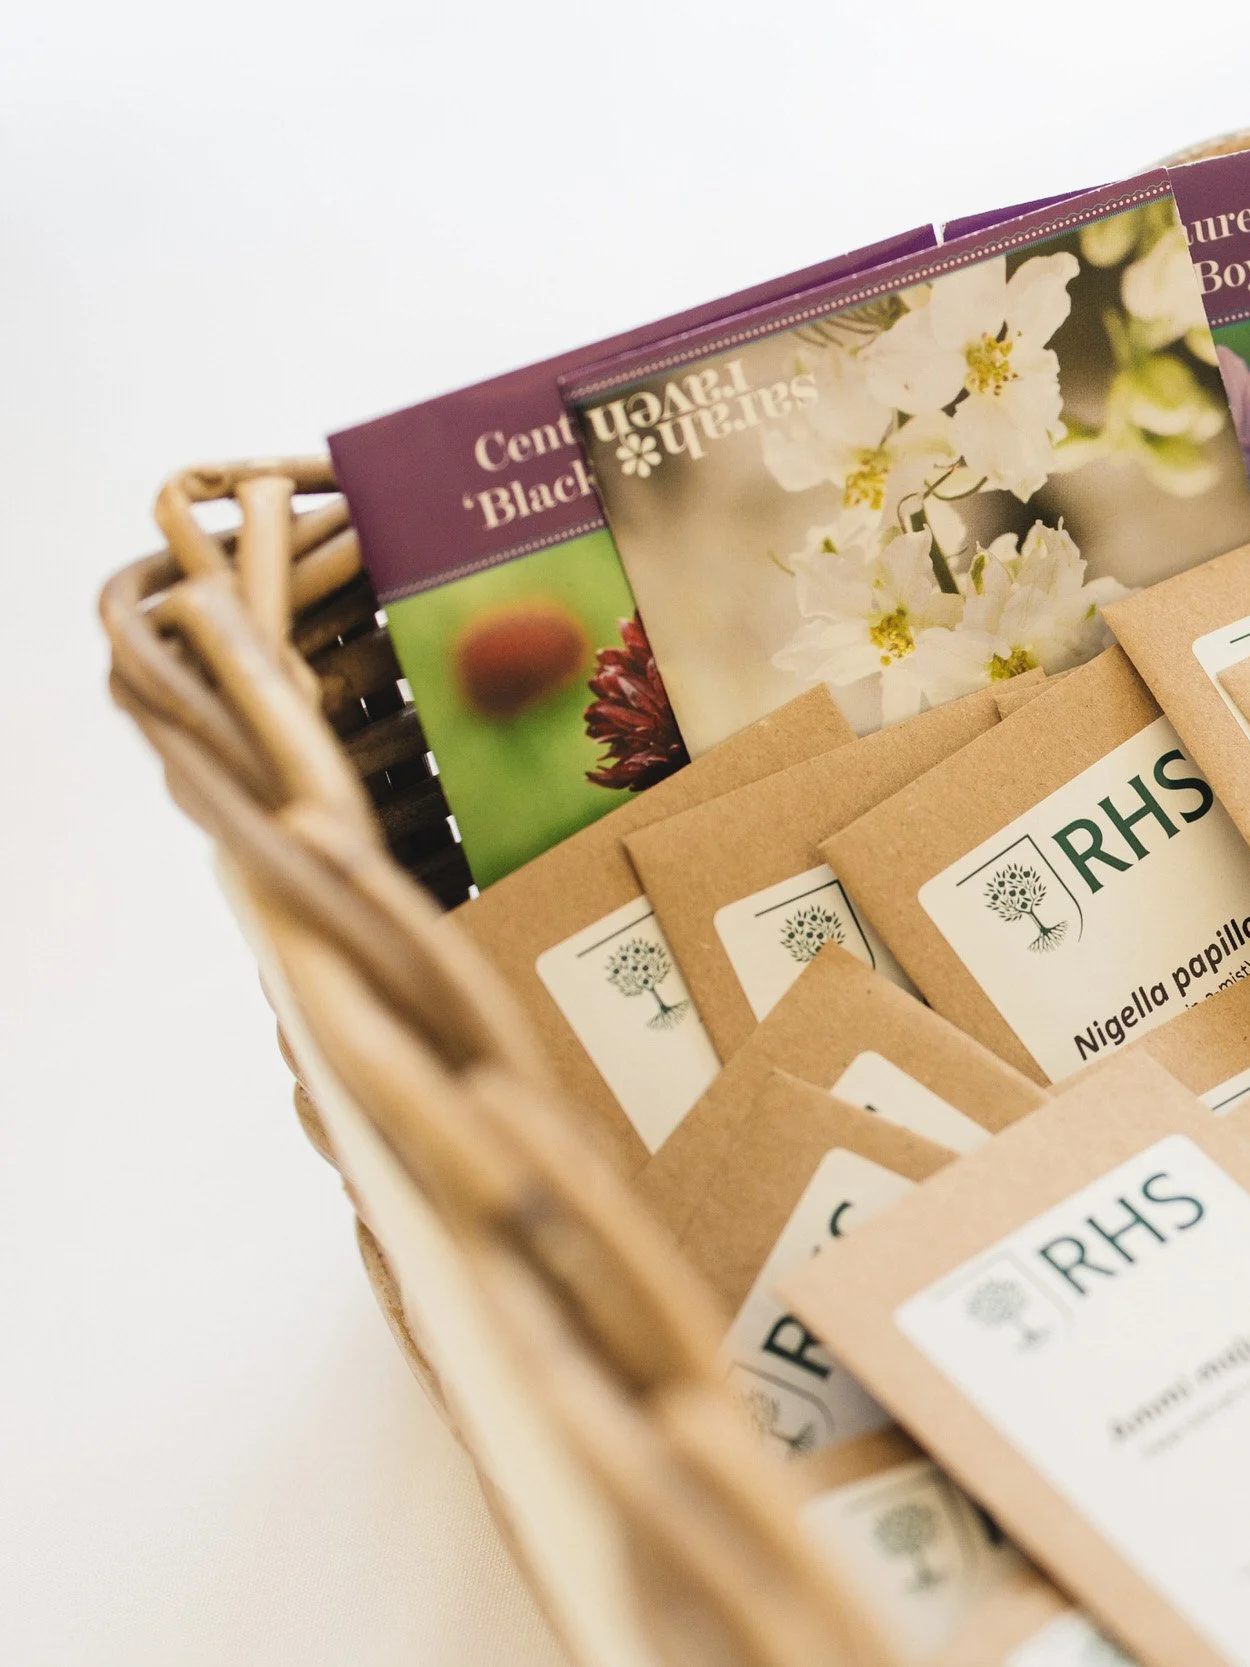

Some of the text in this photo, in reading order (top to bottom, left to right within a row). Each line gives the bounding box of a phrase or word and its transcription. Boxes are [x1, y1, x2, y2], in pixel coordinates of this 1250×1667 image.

[475, 413, 576, 472] Cent
[585, 360, 751, 444] raven
[654, 373, 818, 460] sarah
[1051, 749, 1214, 894] RHS
[1073, 981, 1170, 1061] Nigella
[1037, 1171, 1205, 1295] RHS
